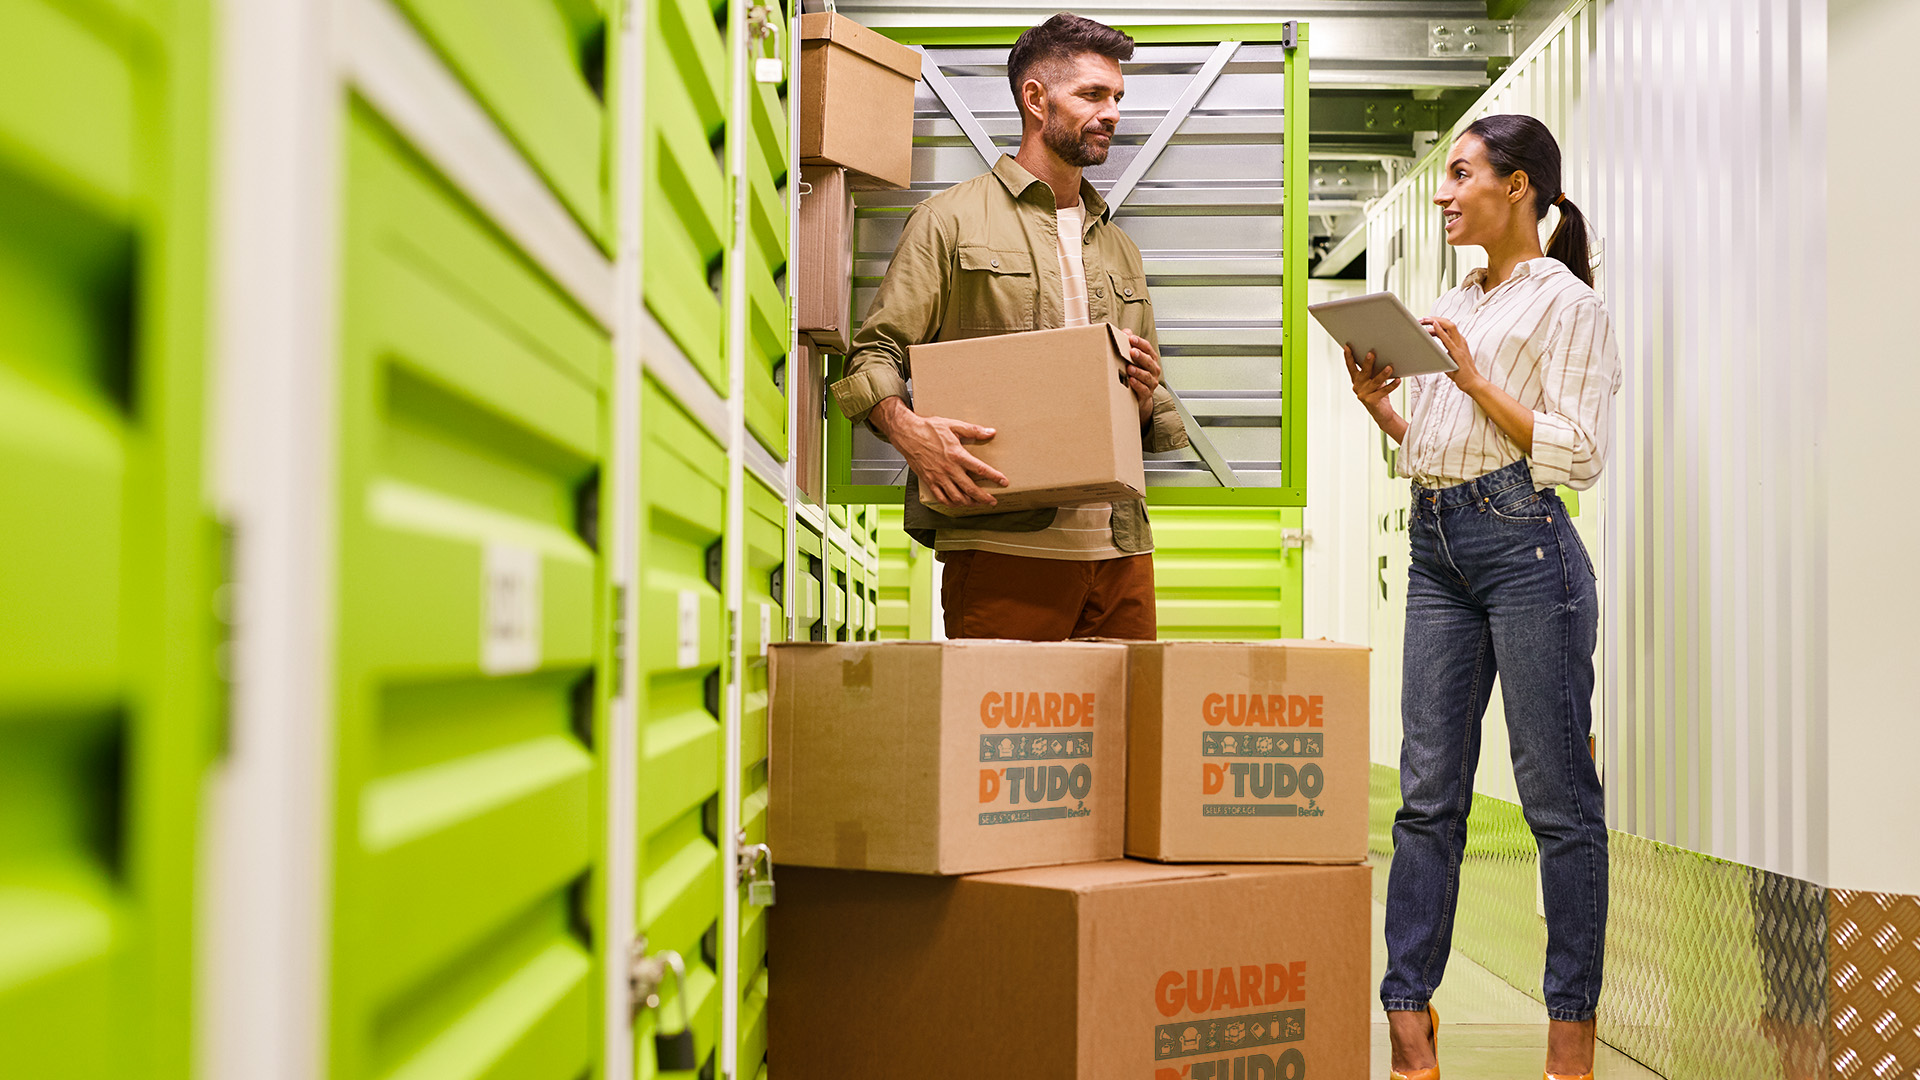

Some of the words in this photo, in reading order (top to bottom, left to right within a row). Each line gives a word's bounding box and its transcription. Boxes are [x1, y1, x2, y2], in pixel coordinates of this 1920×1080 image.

[980, 691, 1095, 728] GUARDE
[1202, 692, 1324, 727] GUARDE
[1205, 806, 1222, 815] SELF
[1223, 806, 1256, 815] STORAGE
[1155, 961, 1306, 1017] GUARDE
